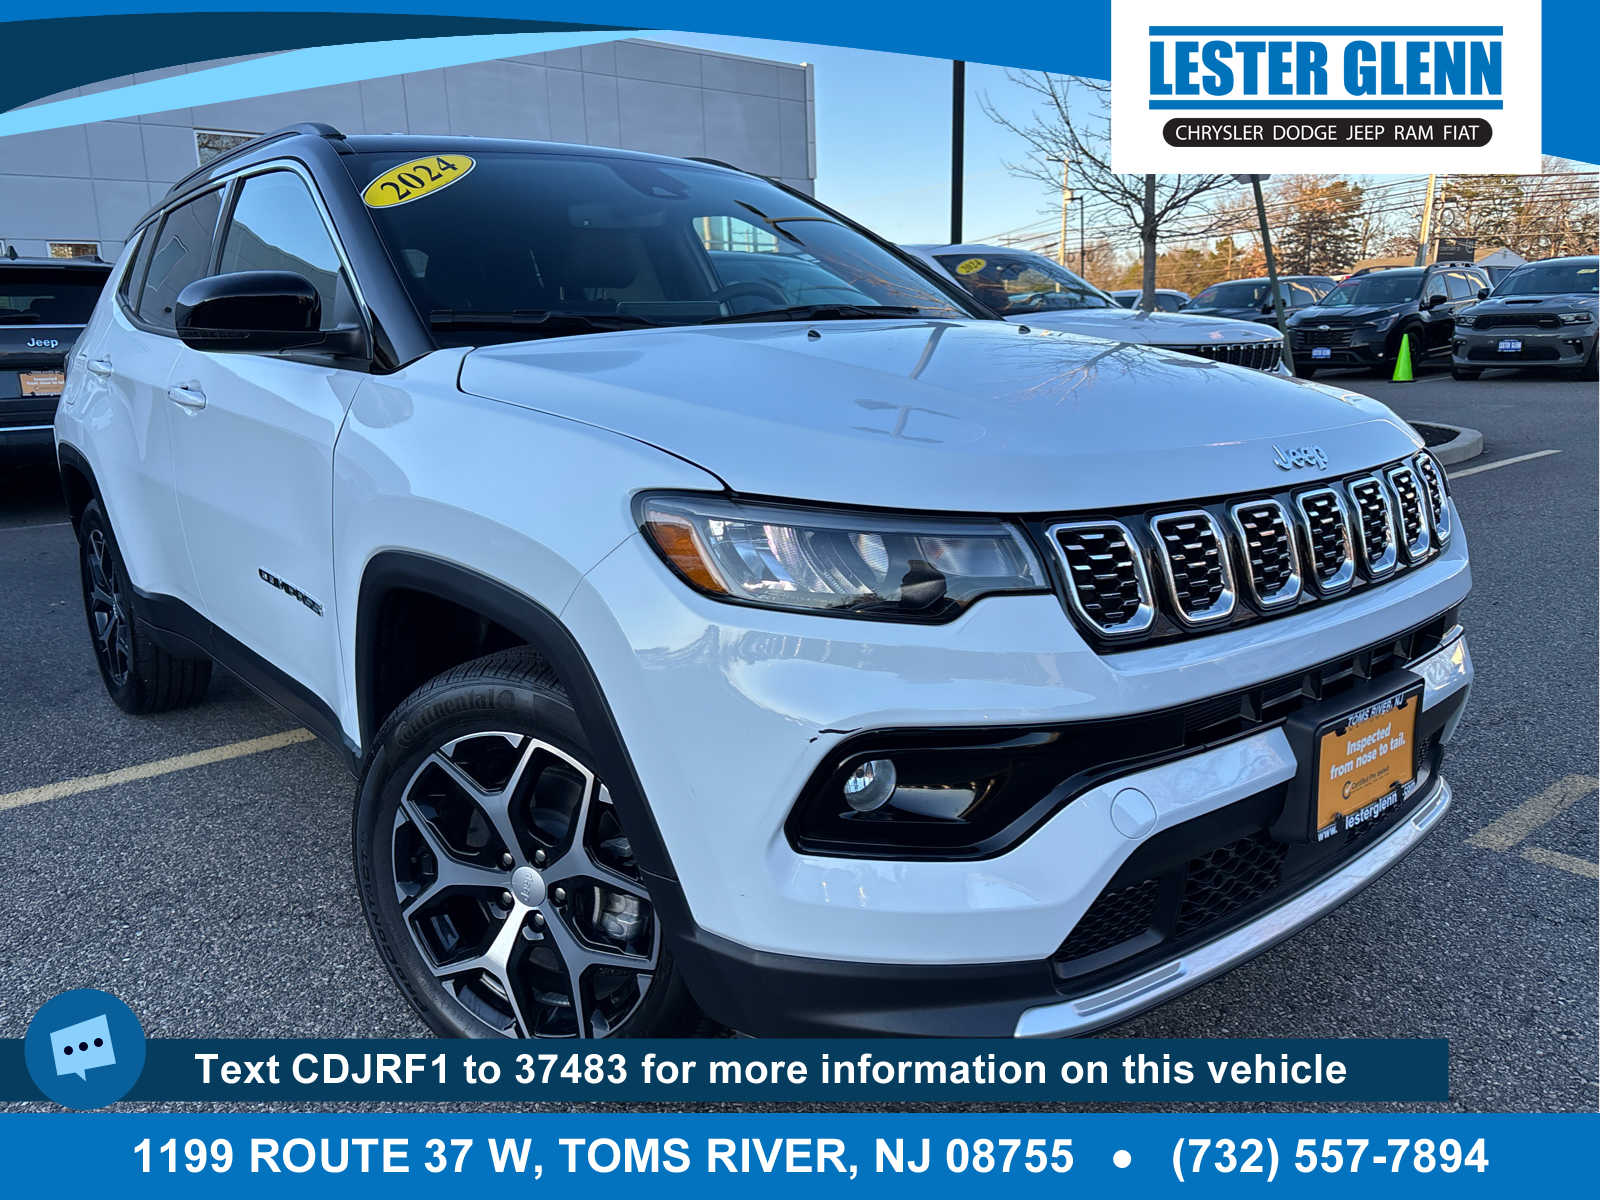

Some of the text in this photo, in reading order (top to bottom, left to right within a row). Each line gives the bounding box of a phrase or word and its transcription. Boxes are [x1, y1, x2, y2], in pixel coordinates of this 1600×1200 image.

[380, 157, 458, 200] 2024
[27, 337, 59, 349] Jeep
[1271, 443, 1329, 472] Jeep
[258, 567, 324, 617] COMPASS
[1347, 708, 1370, 726] TOMS
[1393, 692, 1405, 707] NJ
[1330, 760, 1354, 780] from
[1355, 749, 1377, 768] nose
[1379, 743, 1389, 756] to
[1390, 732, 1406, 750] tail.
[1346, 722, 1392, 756] Inspected
[1345, 791, 1398, 830] lesterglenn
